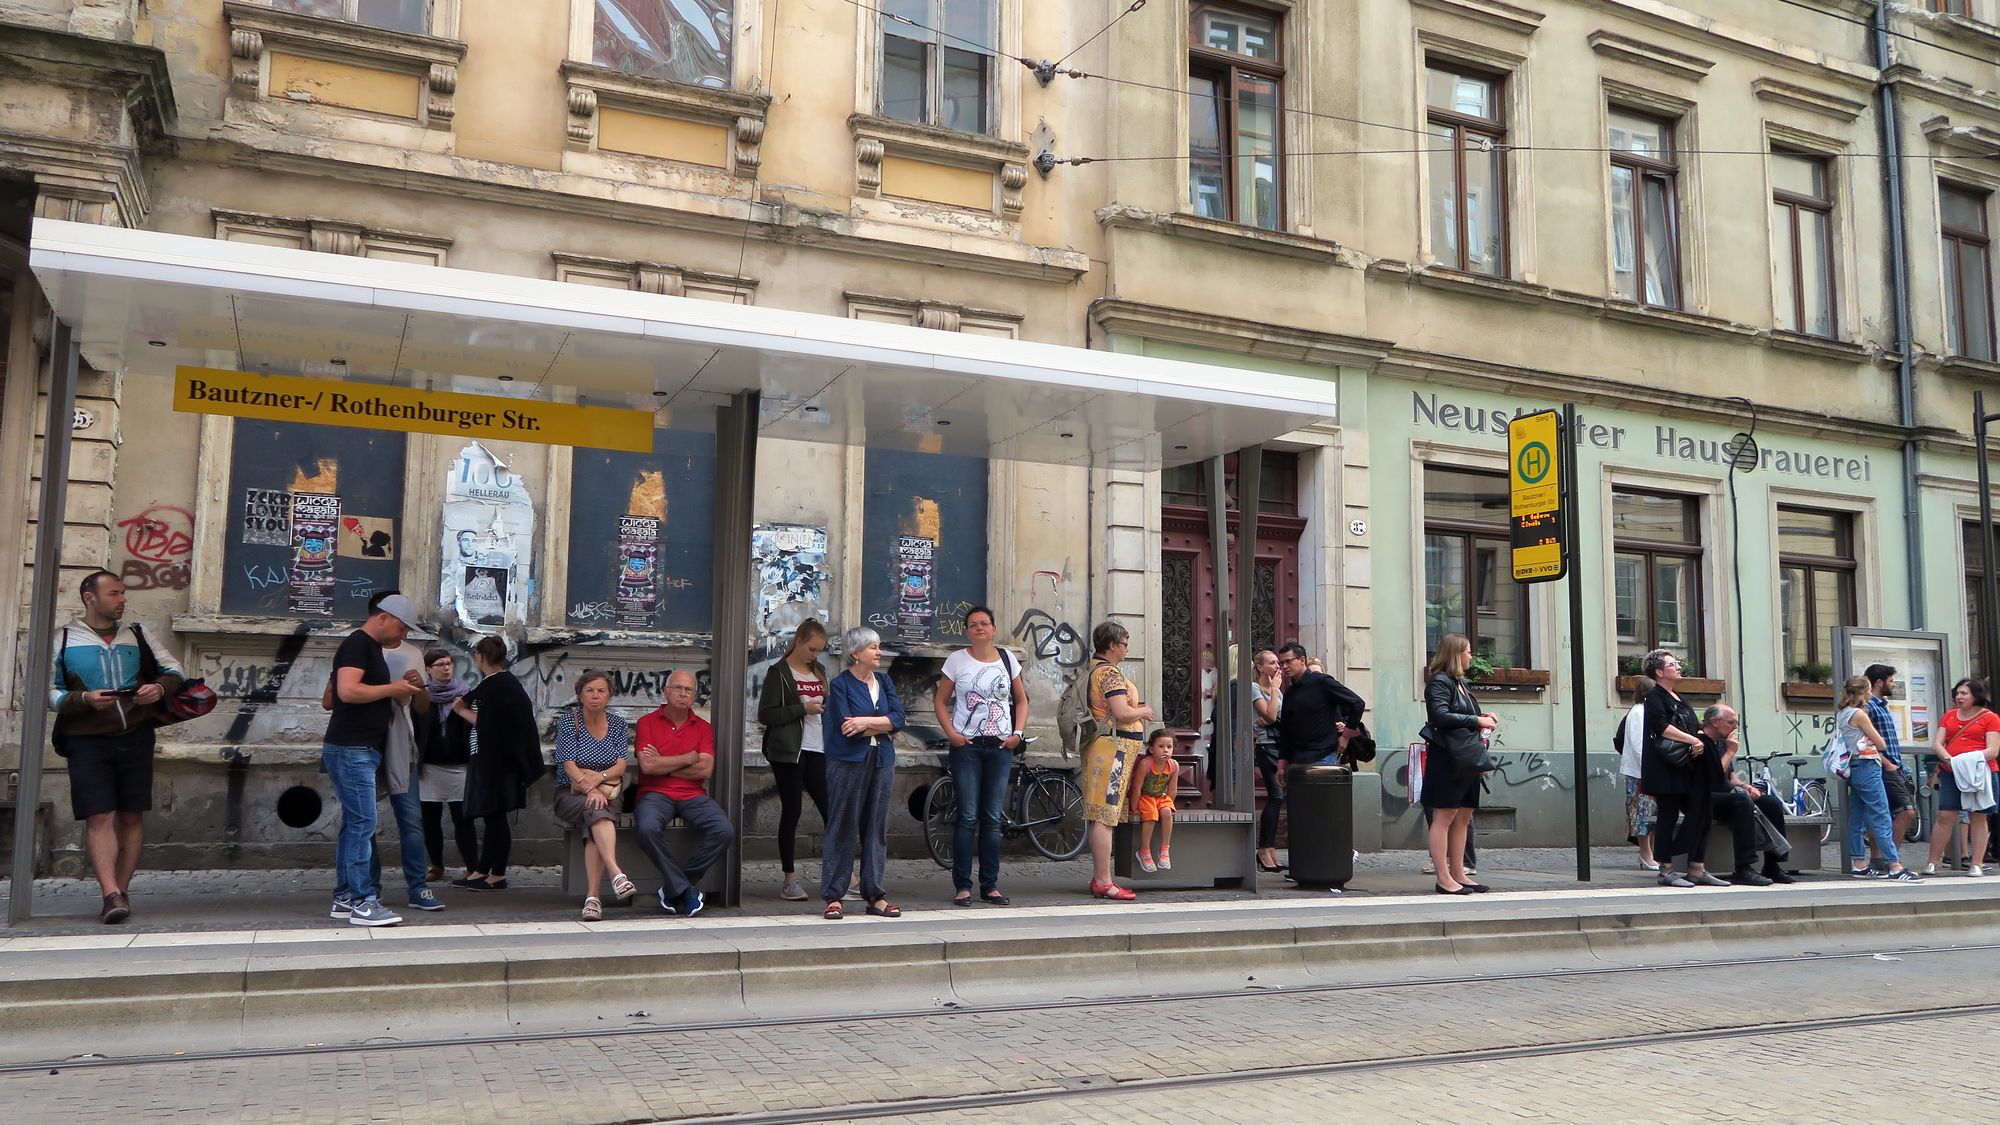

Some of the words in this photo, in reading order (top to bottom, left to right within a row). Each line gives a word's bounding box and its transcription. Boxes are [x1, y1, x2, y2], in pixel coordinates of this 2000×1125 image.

[188, 379, 323, 411] Bautzner-/
[330, 391, 496, 430] Rothenburger
[502, 408, 541, 431] Str.
[1412, 390, 1626, 449] Neuster
[1655, 425, 1872, 482] Hausrauerei
[1527, 450, 1541, 475] H
[468, 488, 510, 499] HELLERAU
